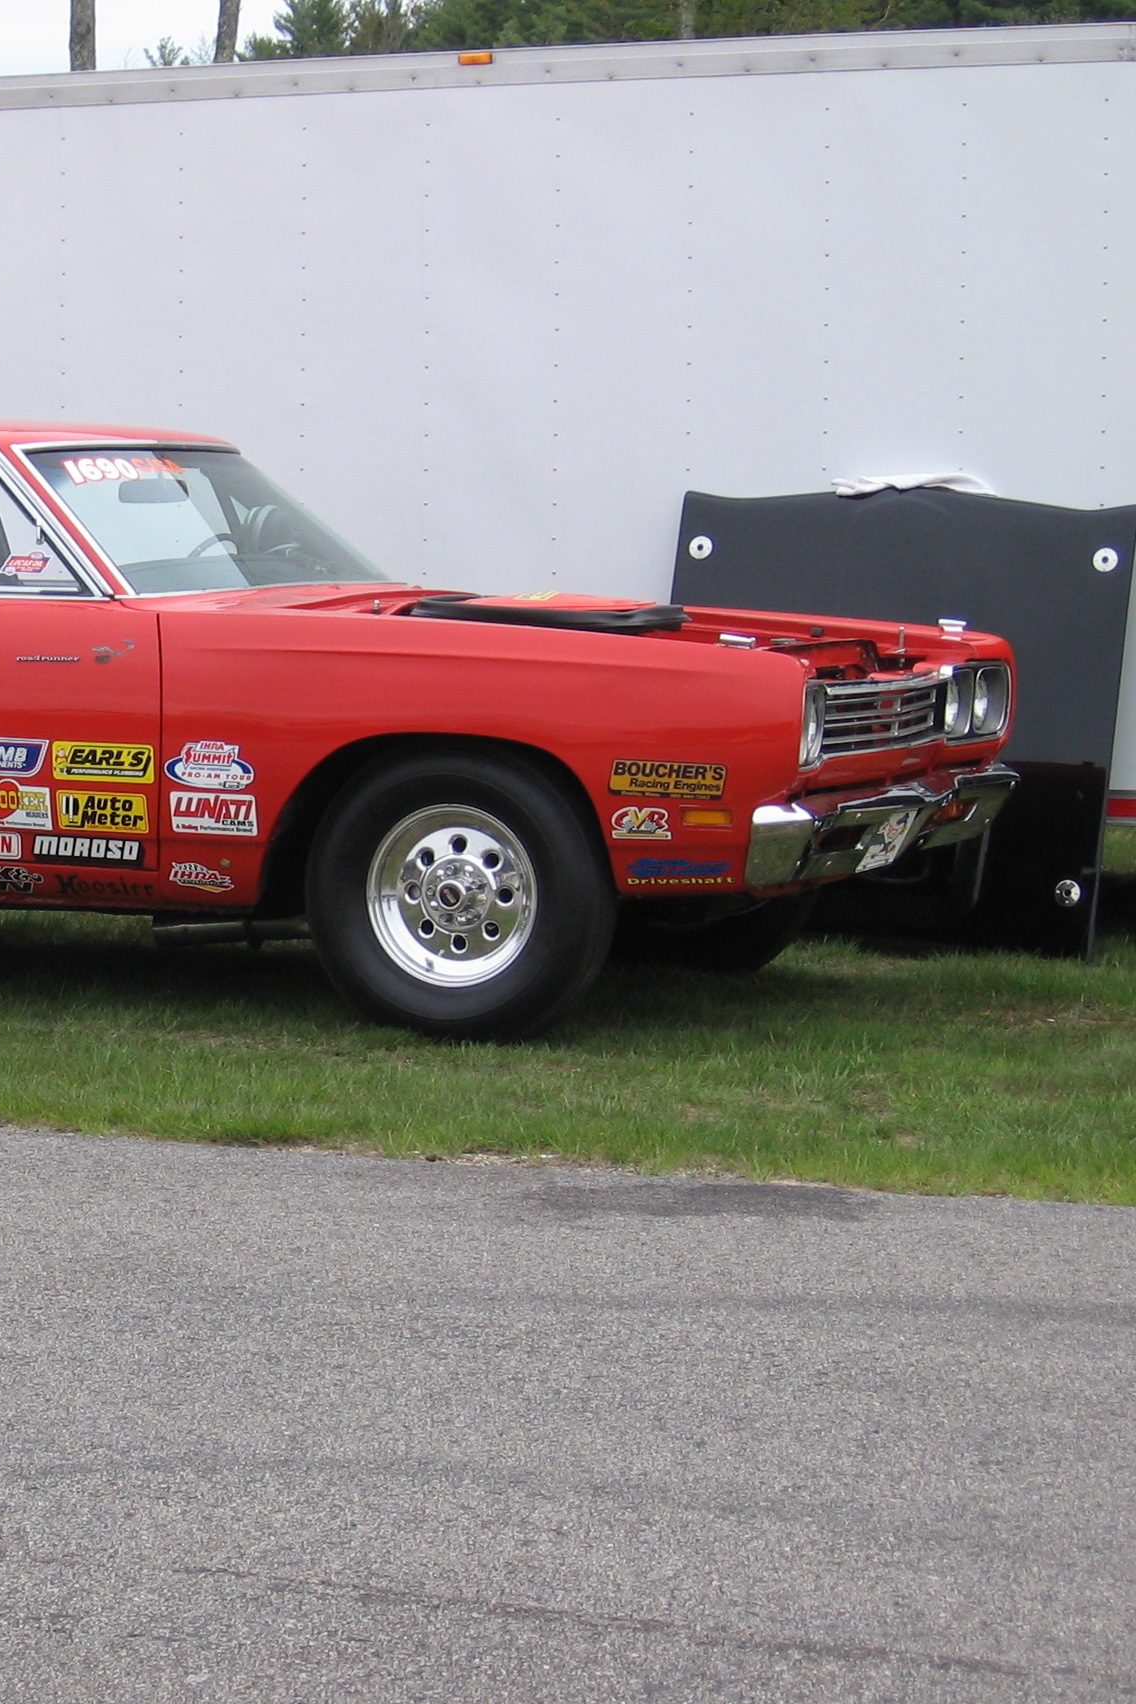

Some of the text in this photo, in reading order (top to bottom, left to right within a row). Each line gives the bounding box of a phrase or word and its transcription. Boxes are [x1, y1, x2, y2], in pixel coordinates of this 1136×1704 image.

[61, 457, 141, 486] 1690
[199, 742, 225, 751] IHRA
[69, 748, 146, 767] EARL'S
[225, 773, 252, 781] TOUR
[613, 761, 724, 781] BOUCHER'S
[629, 777, 722, 792] Racing Engines
[84, 795, 134, 812] Auto
[173, 795, 253, 823] LUNATI
[83, 810, 144, 828] Meter
[222, 819, 254, 827] CAMS
[33, 835, 140, 861] MOROSO
[172, 870, 220, 881] IHRA
[627, 877, 736, 886] Driveshaft
[56, 873, 155, 896] Hoosier
